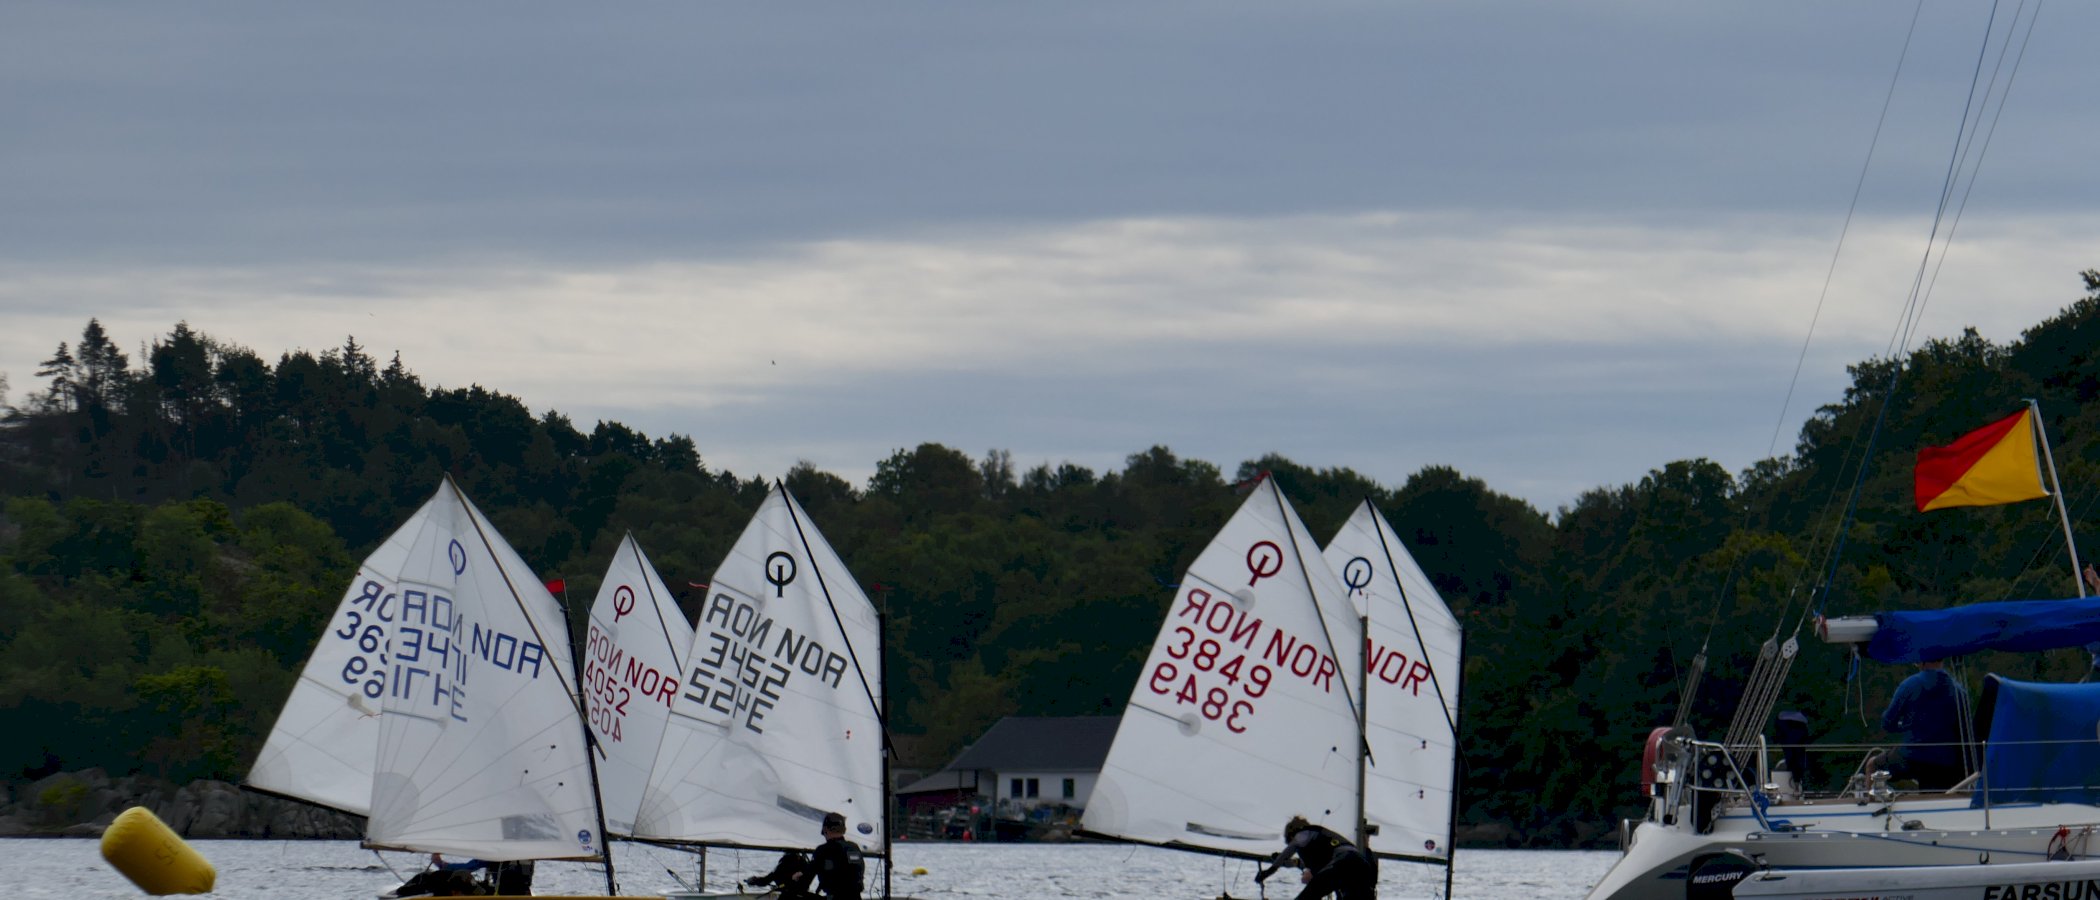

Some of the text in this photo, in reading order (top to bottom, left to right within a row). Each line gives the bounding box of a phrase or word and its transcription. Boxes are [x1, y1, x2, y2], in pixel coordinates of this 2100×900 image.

[396, 626, 467, 686] 3471
[472, 622, 544, 679] NOR
[700, 631, 792, 701] 3452
[774, 627, 848, 690] NOR
[1166, 626, 1272, 698] 3849
[1263, 628, 1336, 693] NOR
[1366, 638, 1431, 697] NOR
[585, 659, 630, 717] 4052
[624, 656, 679, 709] NOR
[1692, 871, 1743, 885] MERCURY
